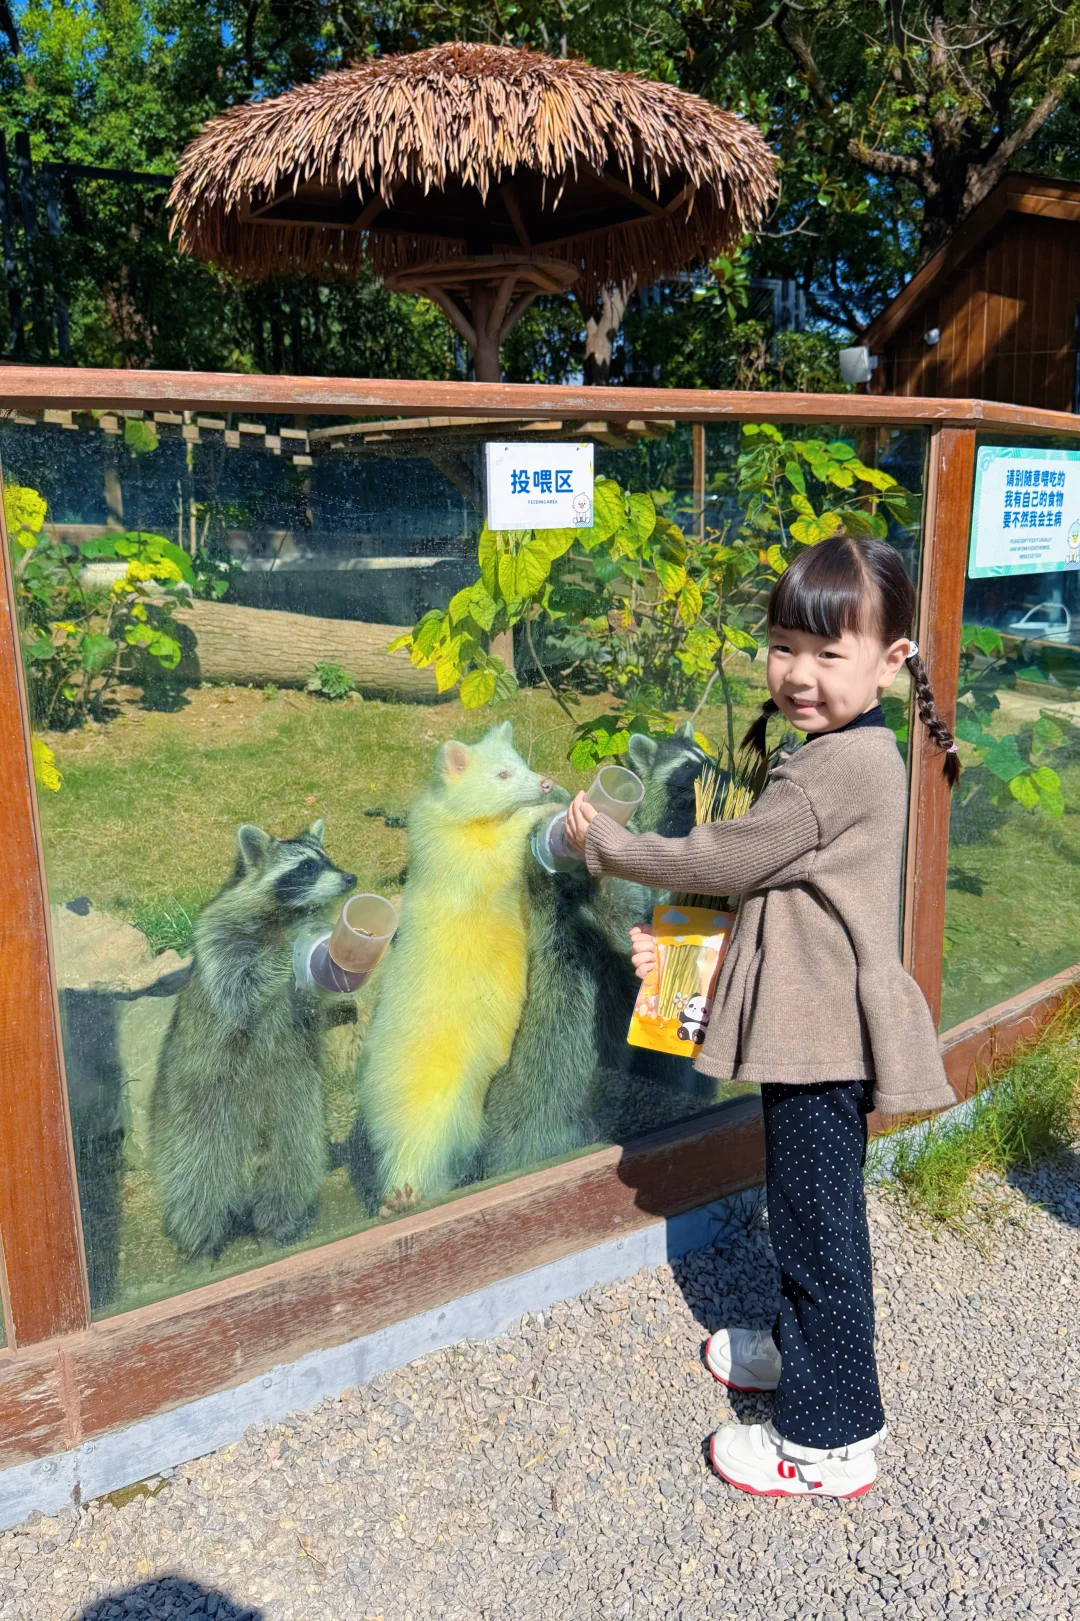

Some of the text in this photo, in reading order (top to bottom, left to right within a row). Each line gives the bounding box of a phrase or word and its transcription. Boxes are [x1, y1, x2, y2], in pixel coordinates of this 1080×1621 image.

[511, 469, 573, 494] 投喂区
[1006, 469, 1066, 487] 请别随意喂吃的
[1004, 490, 1064, 508] 我有自己的食物
[1003, 511, 1062, 529] 要不然我会生病
